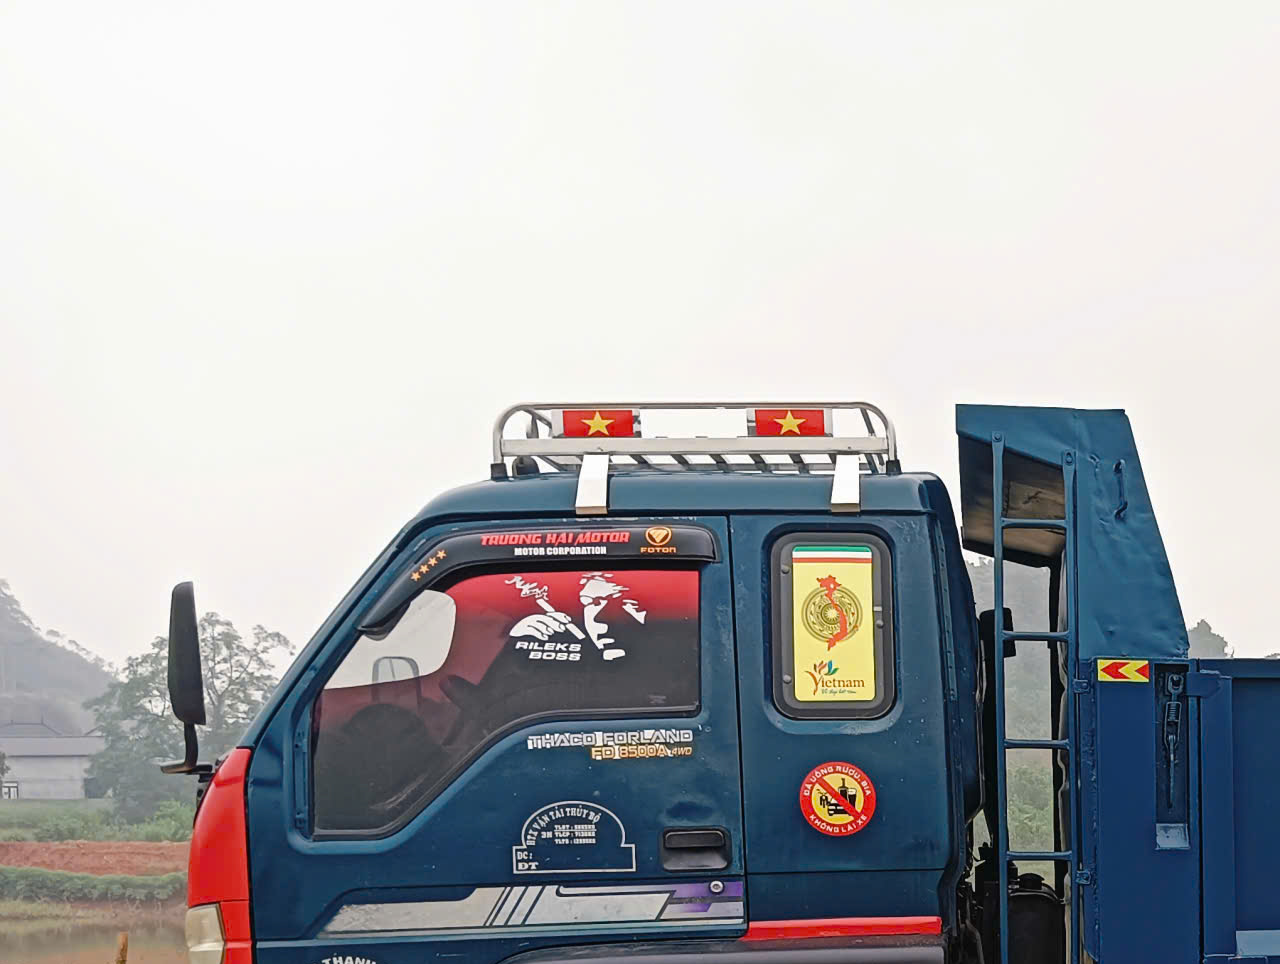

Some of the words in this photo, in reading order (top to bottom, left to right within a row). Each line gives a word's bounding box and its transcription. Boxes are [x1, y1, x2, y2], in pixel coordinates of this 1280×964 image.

[574, 531, 631, 546] MOTOR
[514, 547, 544, 556] MOTOR
[546, 546, 607, 555] CORPORATION
[515, 641, 582, 651] RILEKS
[528, 652, 581, 661] BOSS
[804, 671, 865, 696] Vietnam
[528, 732, 595, 748] THACO
[604, 729, 693, 744] FORLAND
[591, 747, 614, 759] FD
[619, 744, 667, 758] 8500A
[671, 746, 692, 755] 4WD
[857, 814, 868, 825] XE
